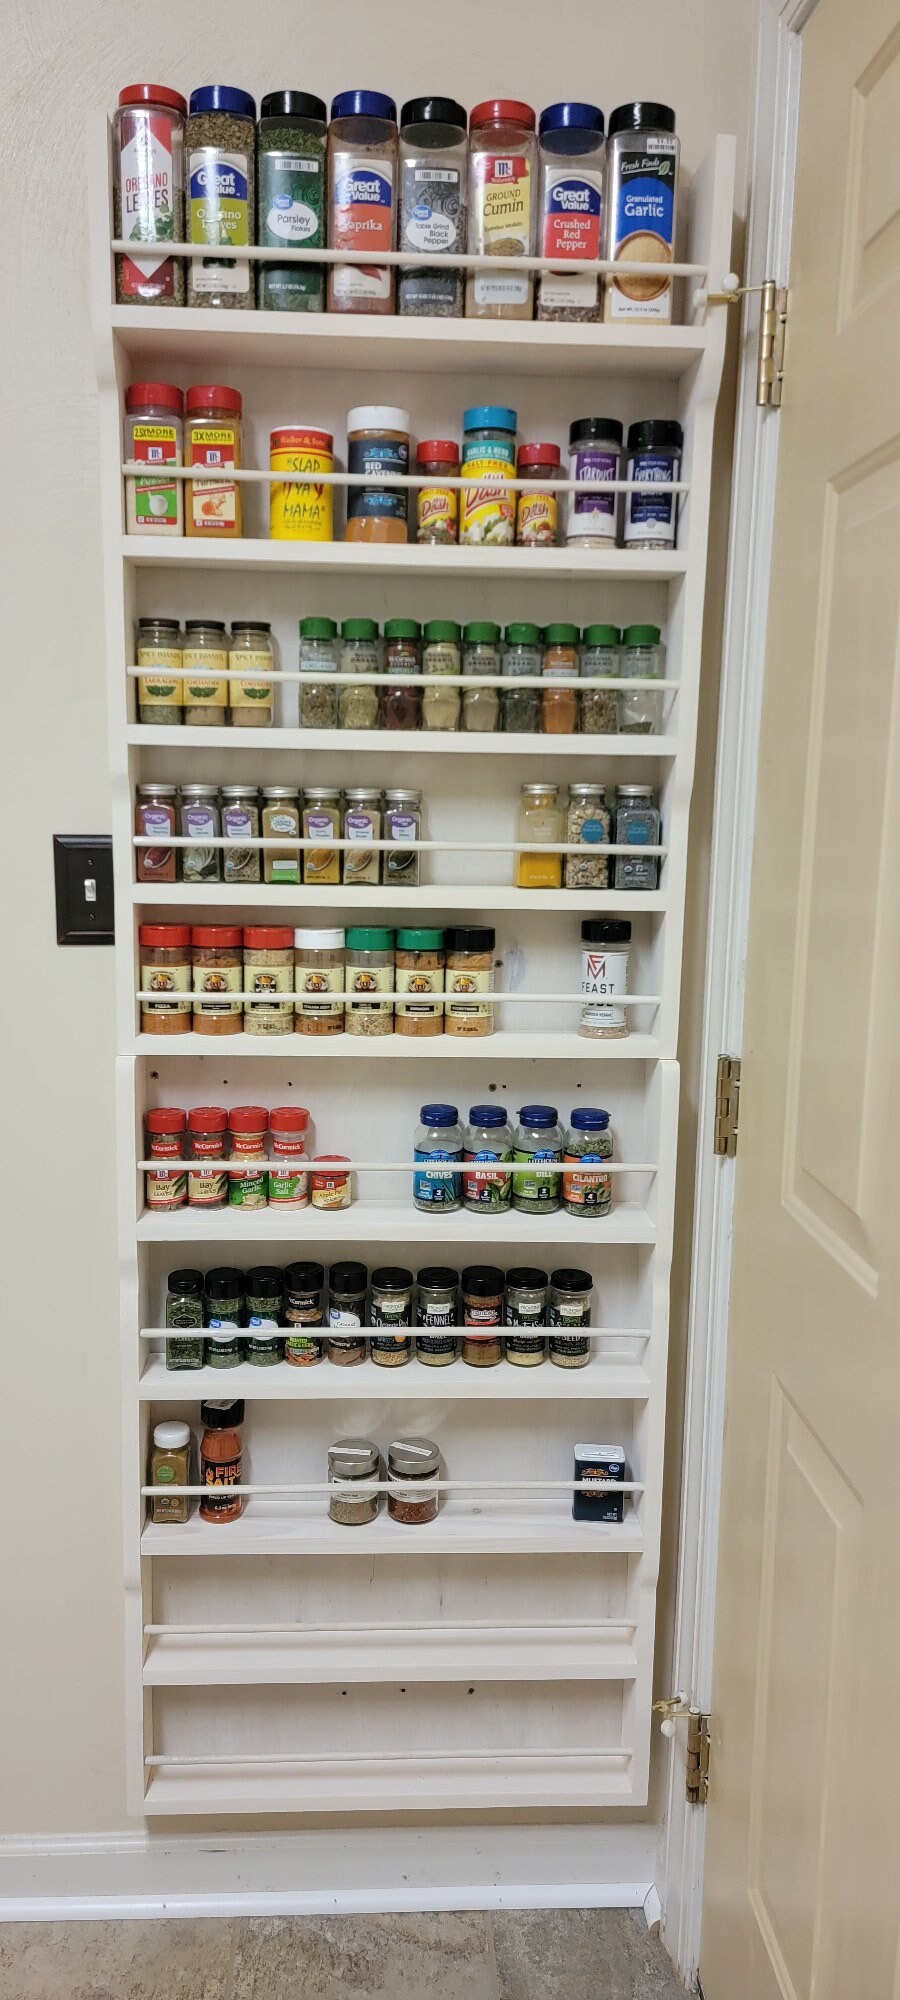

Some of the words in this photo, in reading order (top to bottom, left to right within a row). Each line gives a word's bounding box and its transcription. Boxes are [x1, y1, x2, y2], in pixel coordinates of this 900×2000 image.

[621, 160, 640, 172] Fresh
[641, 157, 660, 168] Finds
[353, 191, 381, 202] Value
[486, 189, 521, 202] GROUND
[552, 187, 590, 202] Great
[626, 195, 664, 203] Granulated
[483, 199, 524, 217] Cumin
[561, 200, 590, 211] Value
[624, 203, 664, 218] Garlic
[277, 214, 311, 227] Parsley
[553, 219, 591, 229] Crushed
[291, 225, 311, 233] Flakes
[430, 230, 449, 238] Black
[563, 229, 581, 239] Red
[424, 237, 449, 246] Pepper
[556, 239, 587, 251] Pepper
[147, 428, 175, 437] MORE
[193, 431, 205, 441] 3X
[205, 432, 233, 440] MORE
[365, 461, 382, 470] RED
[581, 982, 615, 994] FEAST
[426, 1171, 453, 1179] CHIVES
[475, 1171, 499, 1180] BASIL
[572, 1173, 608, 1183] CILANTRO
[200, 1182, 214, 1190] Bay
[240, 1176, 264, 1189] Minced
[273, 1181, 293, 1189] Garlic
[155, 1184, 170, 1192] Bay
[241, 1185, 262, 1194] Garlic
[425, 1314, 451, 1326] FENNEL
